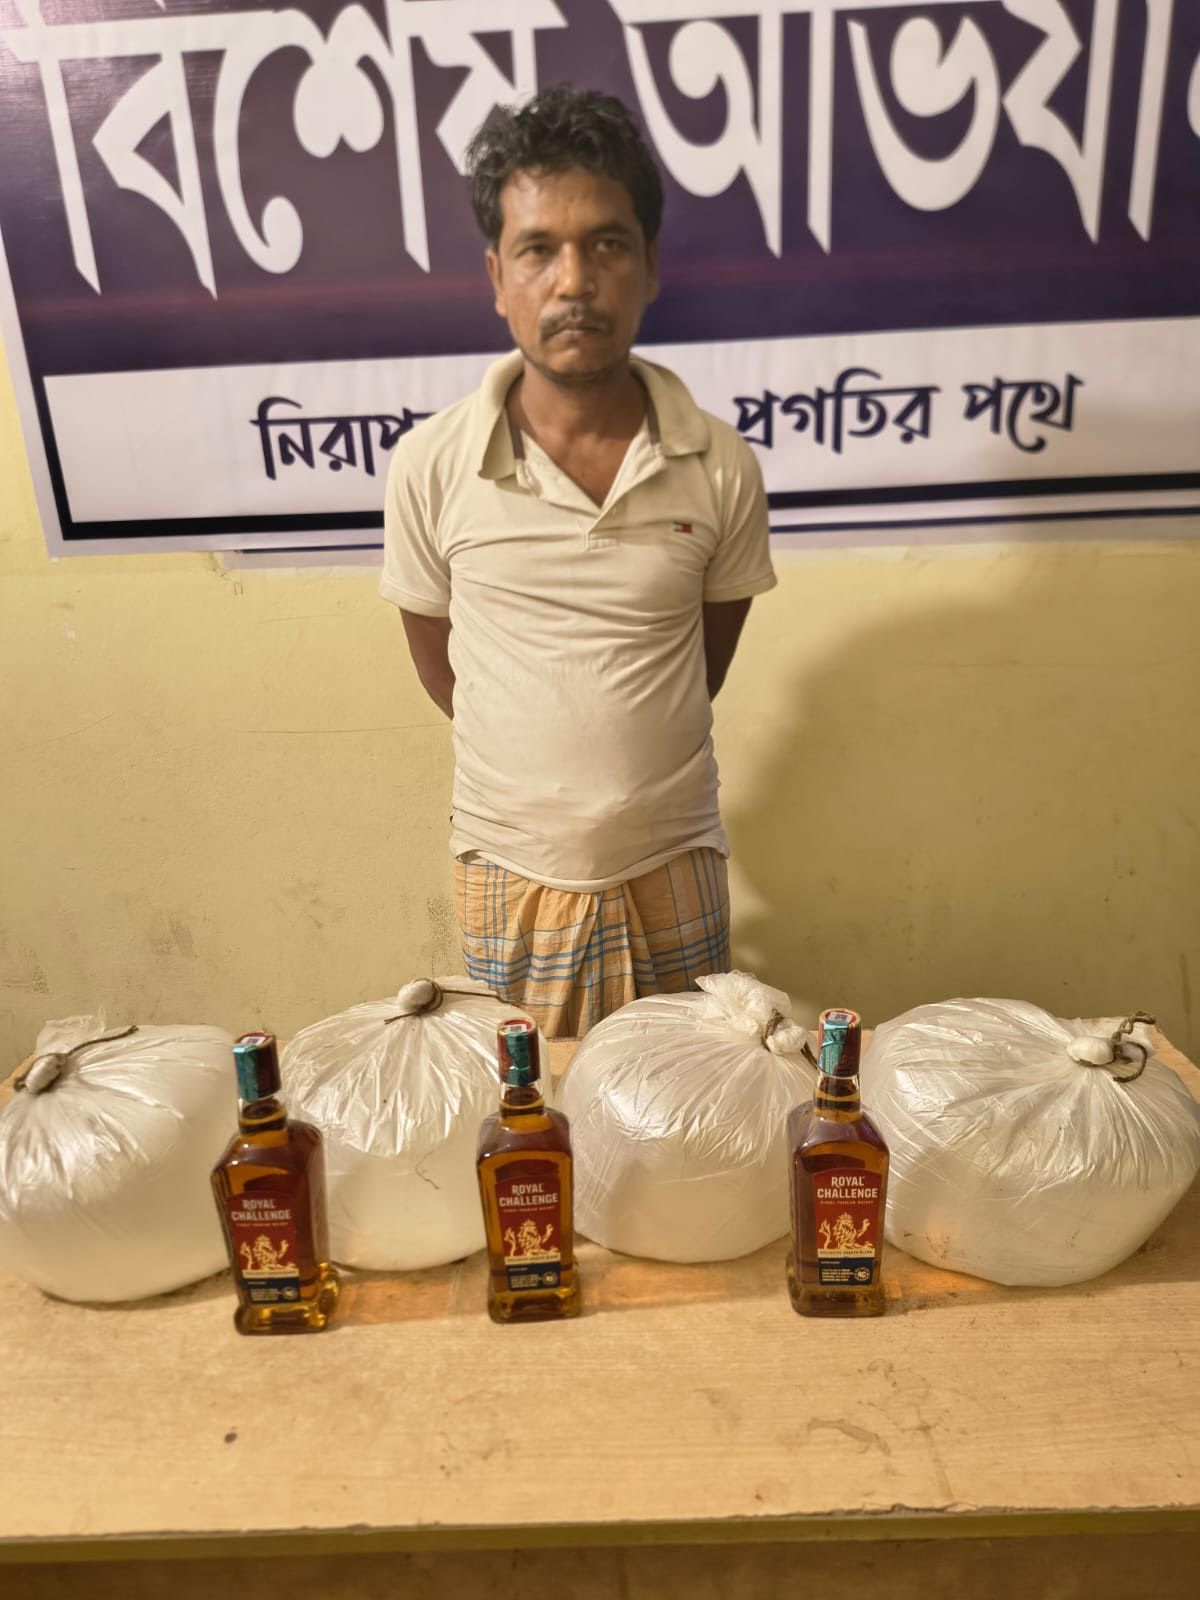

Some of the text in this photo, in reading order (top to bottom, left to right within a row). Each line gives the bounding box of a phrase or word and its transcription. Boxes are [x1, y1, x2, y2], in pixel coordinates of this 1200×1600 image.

[606, 0, 1200, 258] অভিযা
[248, 367, 1084, 482] নিরাপ প্রগতির পথে
[831, 1175, 864, 1188] ROYAL
[511, 1183, 544, 1196] ROYAL
[817, 1187, 878, 1199] CHALLENGE
[242, 1199, 276, 1210] ROYAL
[499, 1193, 559, 1207] CHALLENGE
[231, 1209, 291, 1221] CHALLENGE
